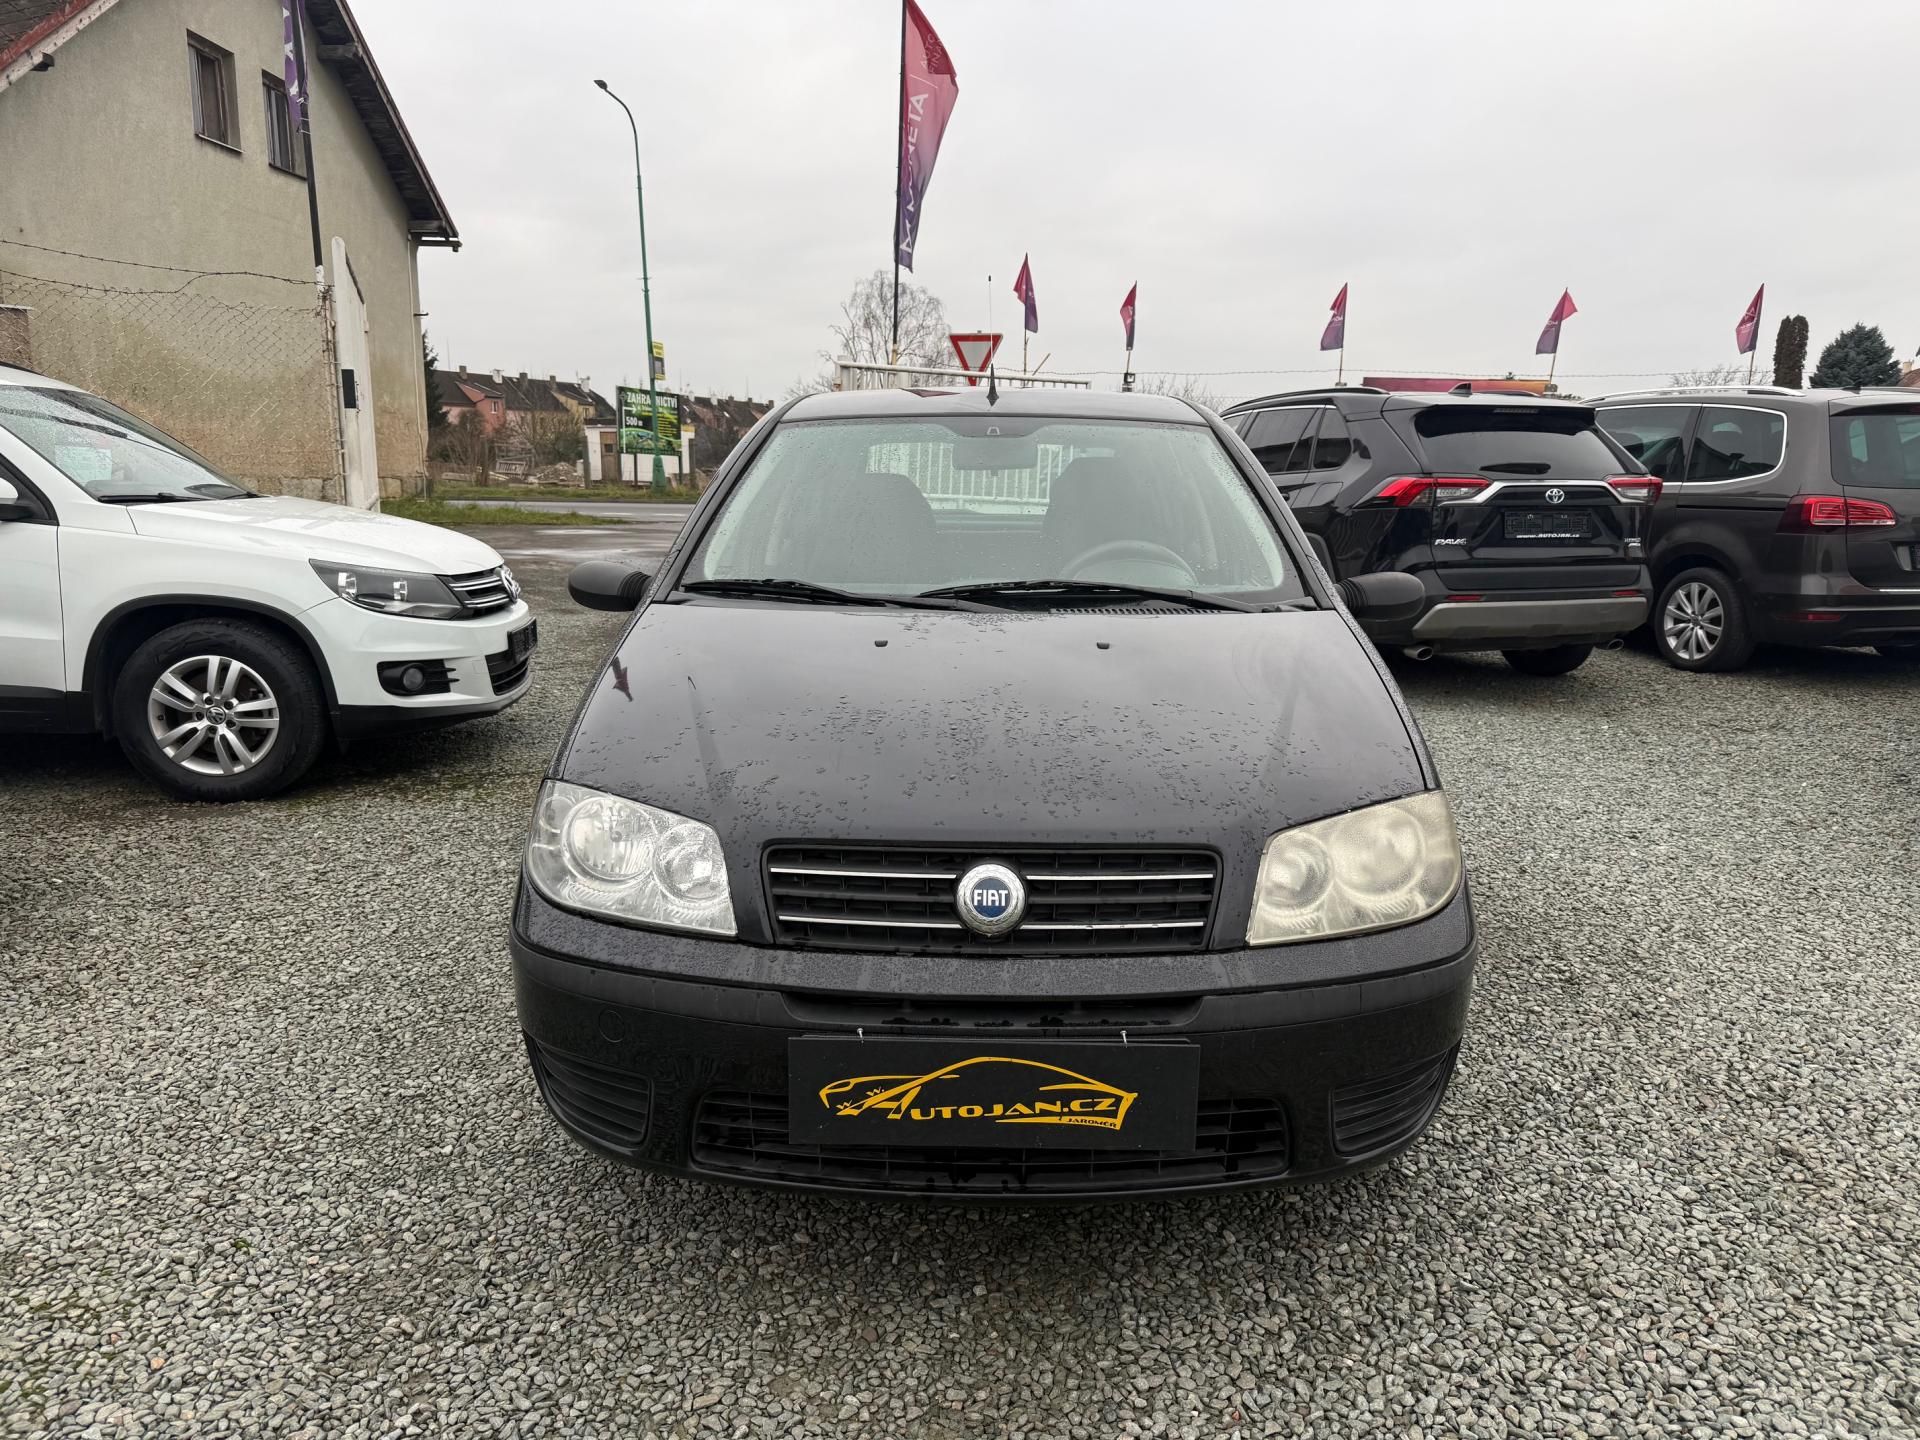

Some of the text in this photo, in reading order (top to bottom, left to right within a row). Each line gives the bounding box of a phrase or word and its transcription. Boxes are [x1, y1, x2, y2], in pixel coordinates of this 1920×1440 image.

[626, 392, 678, 409] ZAHRANICTVÍ
[625, 416, 638, 426] 500
[973, 889, 1009, 907] FIAT
